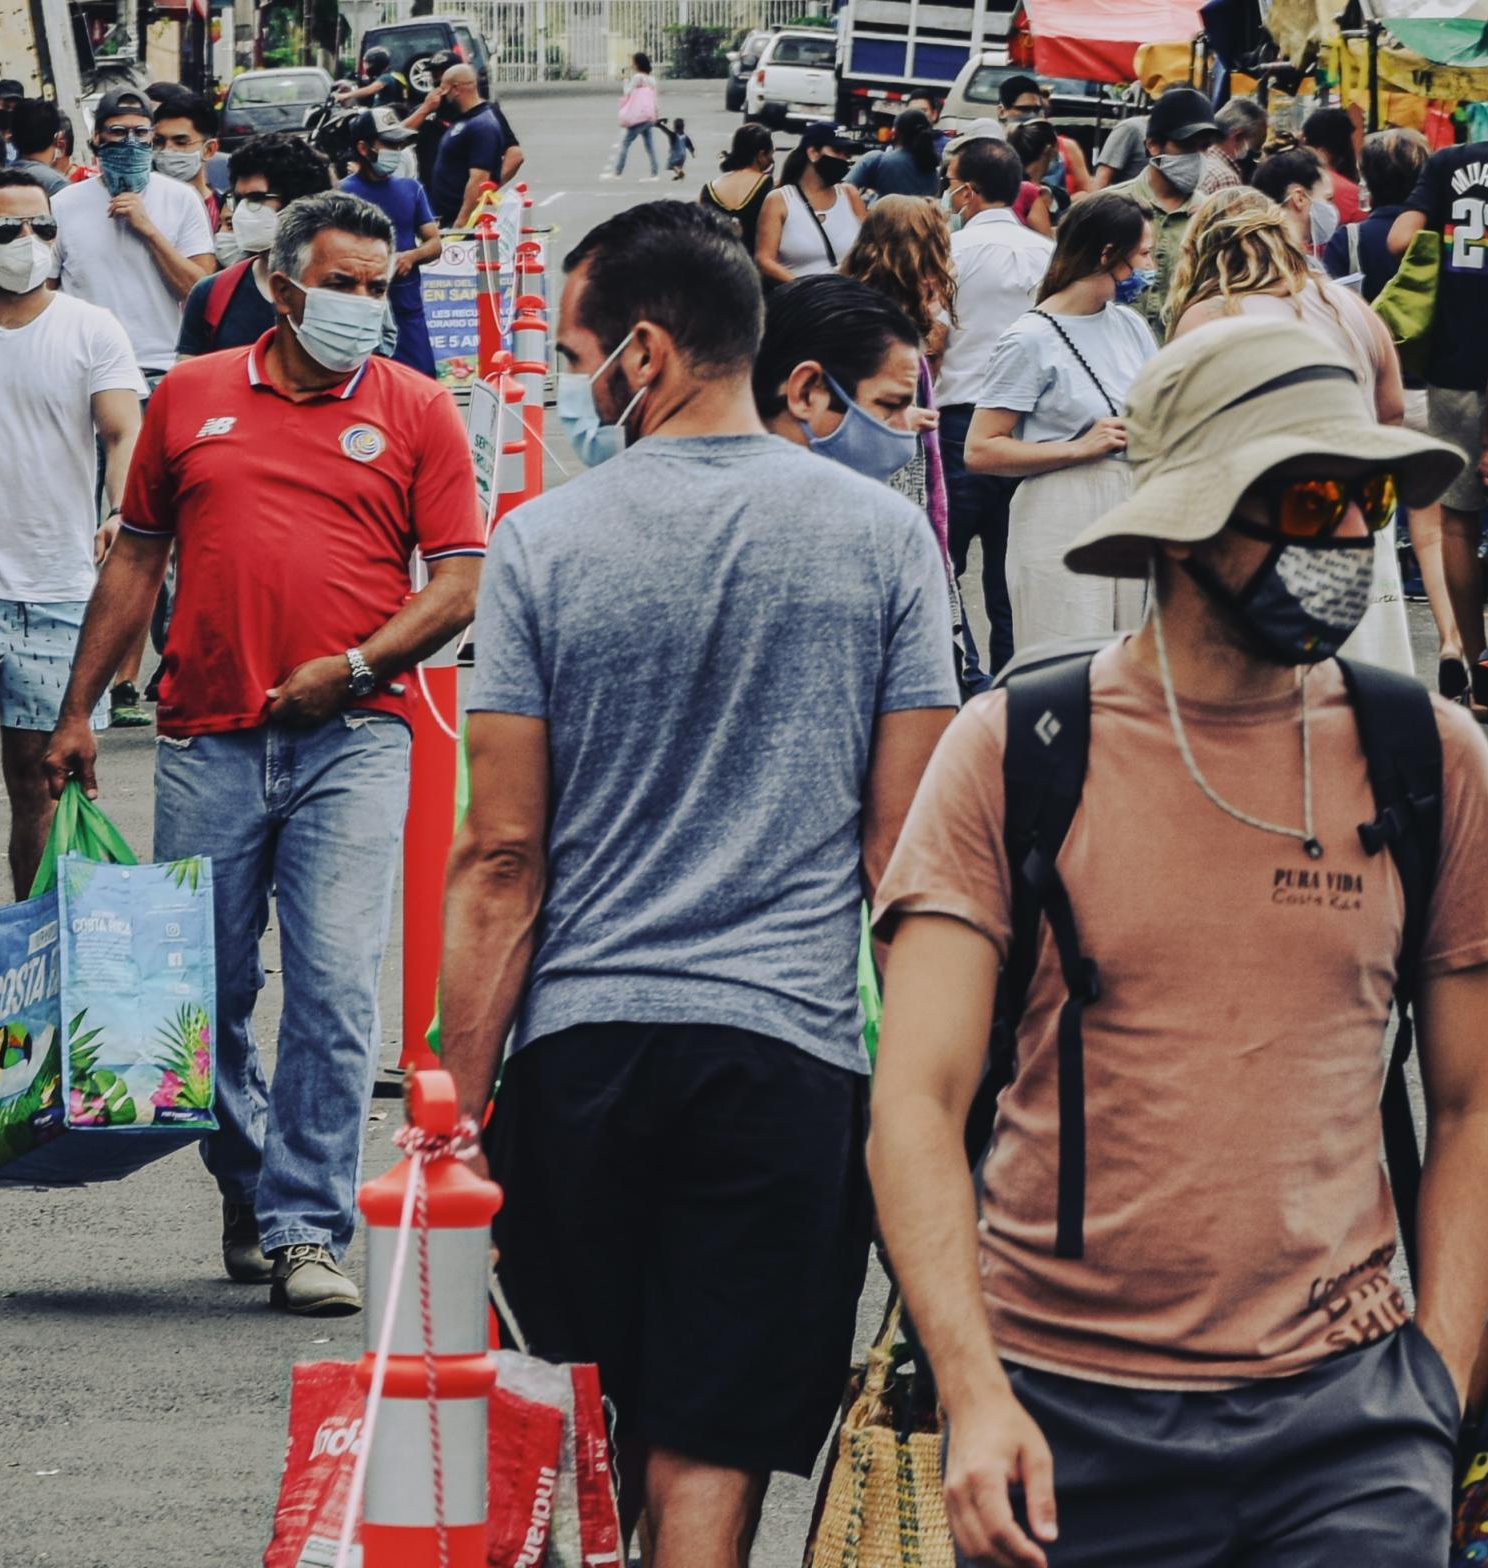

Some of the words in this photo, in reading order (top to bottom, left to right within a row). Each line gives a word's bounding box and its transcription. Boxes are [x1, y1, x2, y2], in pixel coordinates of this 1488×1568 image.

[424, 289, 445, 302] EN
[449, 335, 459, 348] 5
[1274, 869, 1320, 889] PURA
[1326, 872, 1363, 894] VIDA
[1271, 888, 1323, 906] Costa
